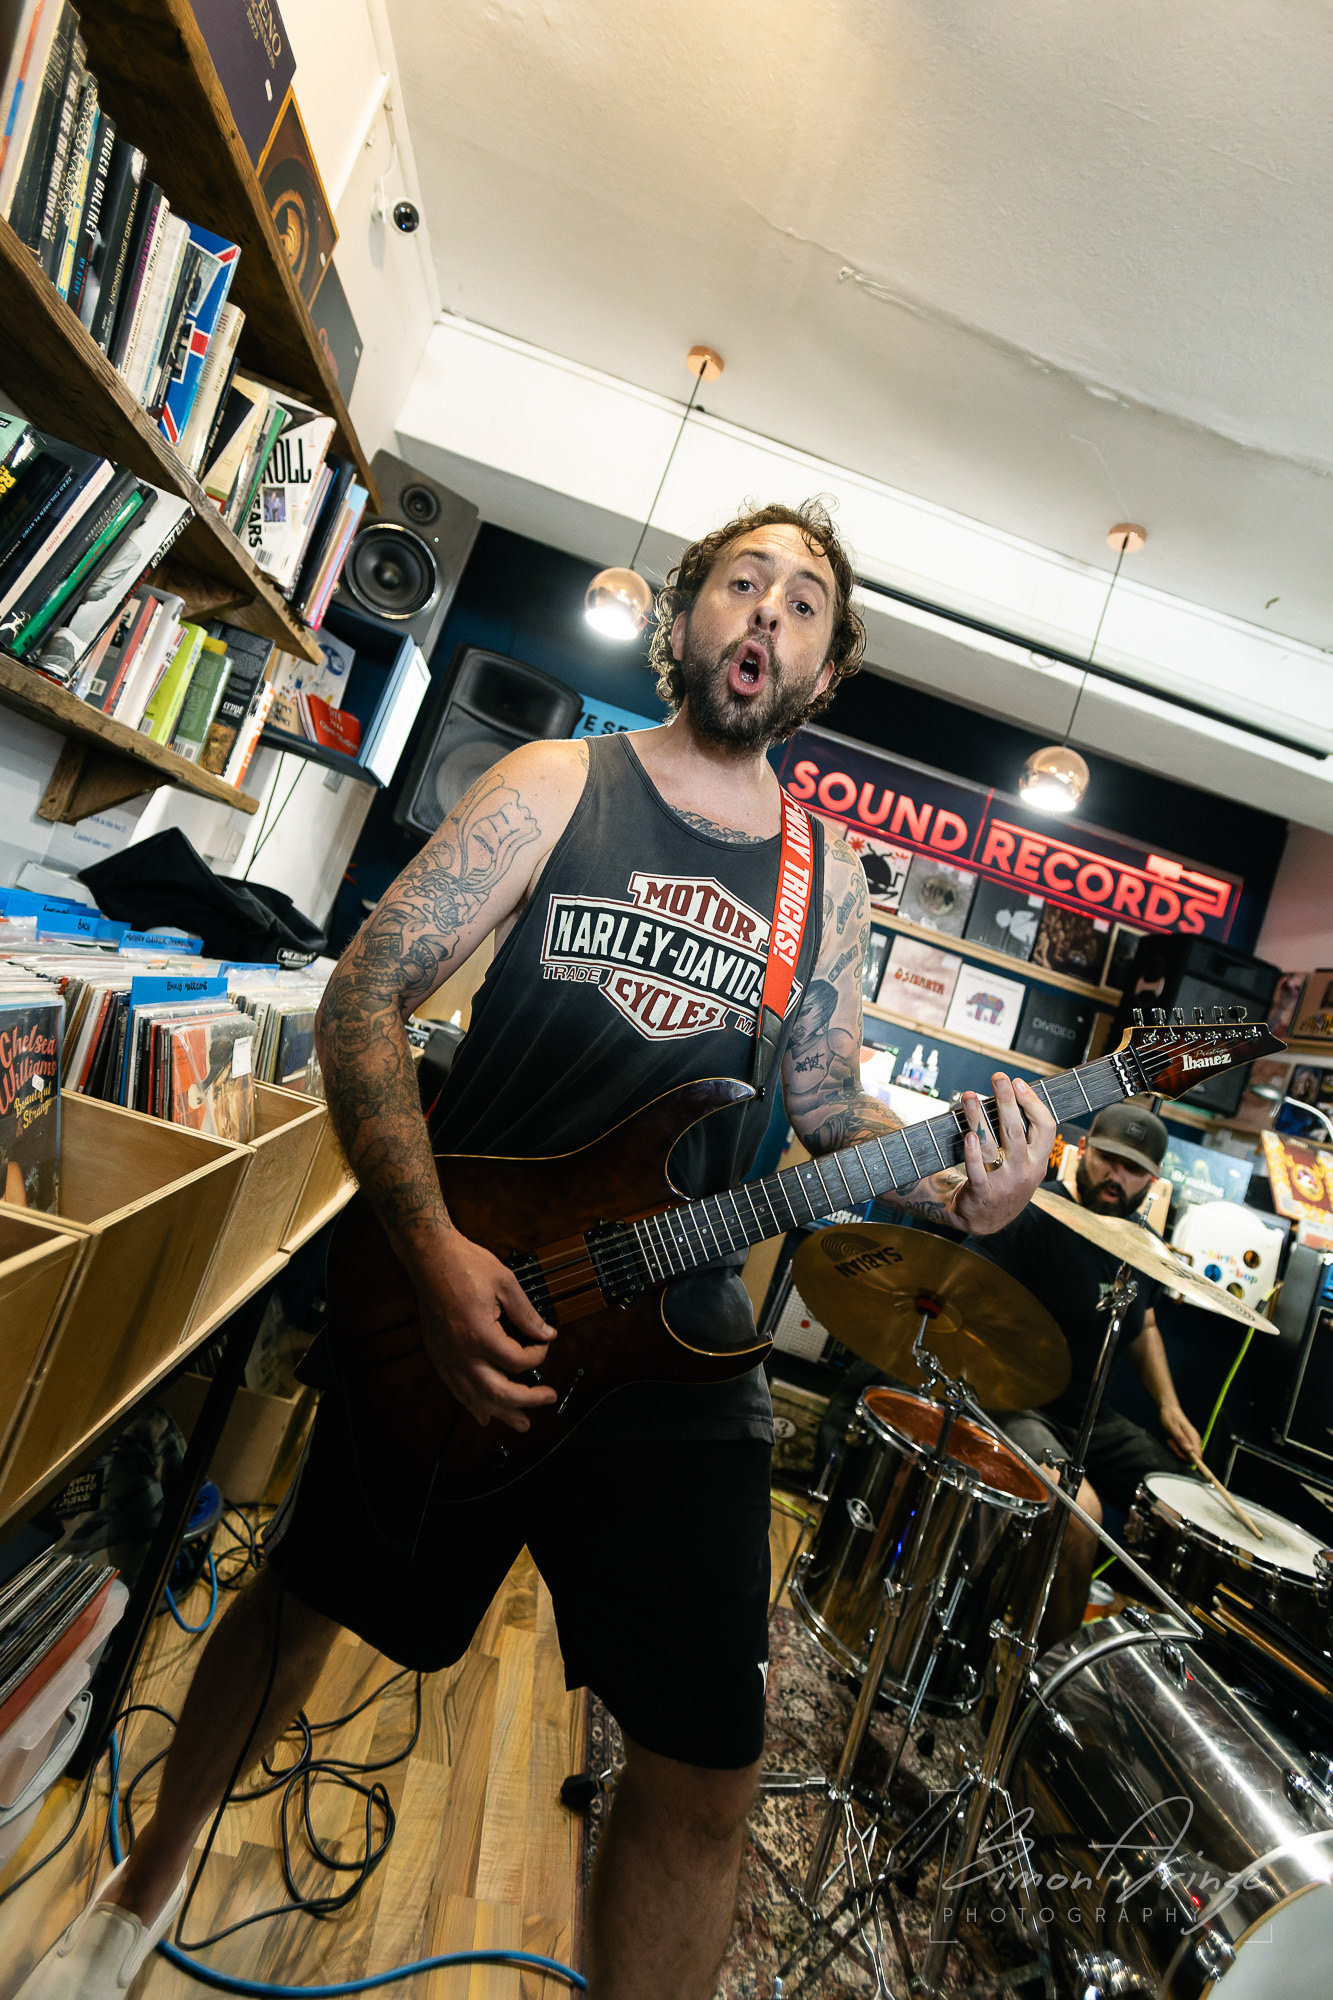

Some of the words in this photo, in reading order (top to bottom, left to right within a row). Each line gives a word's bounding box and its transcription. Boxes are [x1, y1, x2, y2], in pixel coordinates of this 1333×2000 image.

[97, 127, 115, 178] ROGER
[84, 178, 106, 240] DALTREY
[131, 187, 139, 210] WHO
[124, 210, 134, 239] KILLED
[79, 256, 86, 269] MY
[118, 238, 128, 264] JOHN
[73, 271, 83, 296] STORY
[59, 475, 72, 491] DEAD
[40, 490, 60, 516] CHILDREN
[21, 516, 41, 539] PLAYING
[787, 760, 968, 853] SOUND
[980, 826, 1210, 934] RECORDS
[644, 881, 758, 943] MOTOR
[773, 860, 810, 967] TRICKS!
[553, 909, 767, 1005] HARLEY-DAVIDS
[543, 965, 602, 984] TRADE
[614, 977, 720, 1031] CYCLES
[734, 1016, 757, 1036] MA
[0, 1024, 56, 1069] Chelsea
[1181, 1053, 1232, 1072] Ibanez
[0, 1056, 57, 1115] Williams
[834, 1246, 904, 1278] SABIAN
[1208, 1249, 1237, 1266] birth
